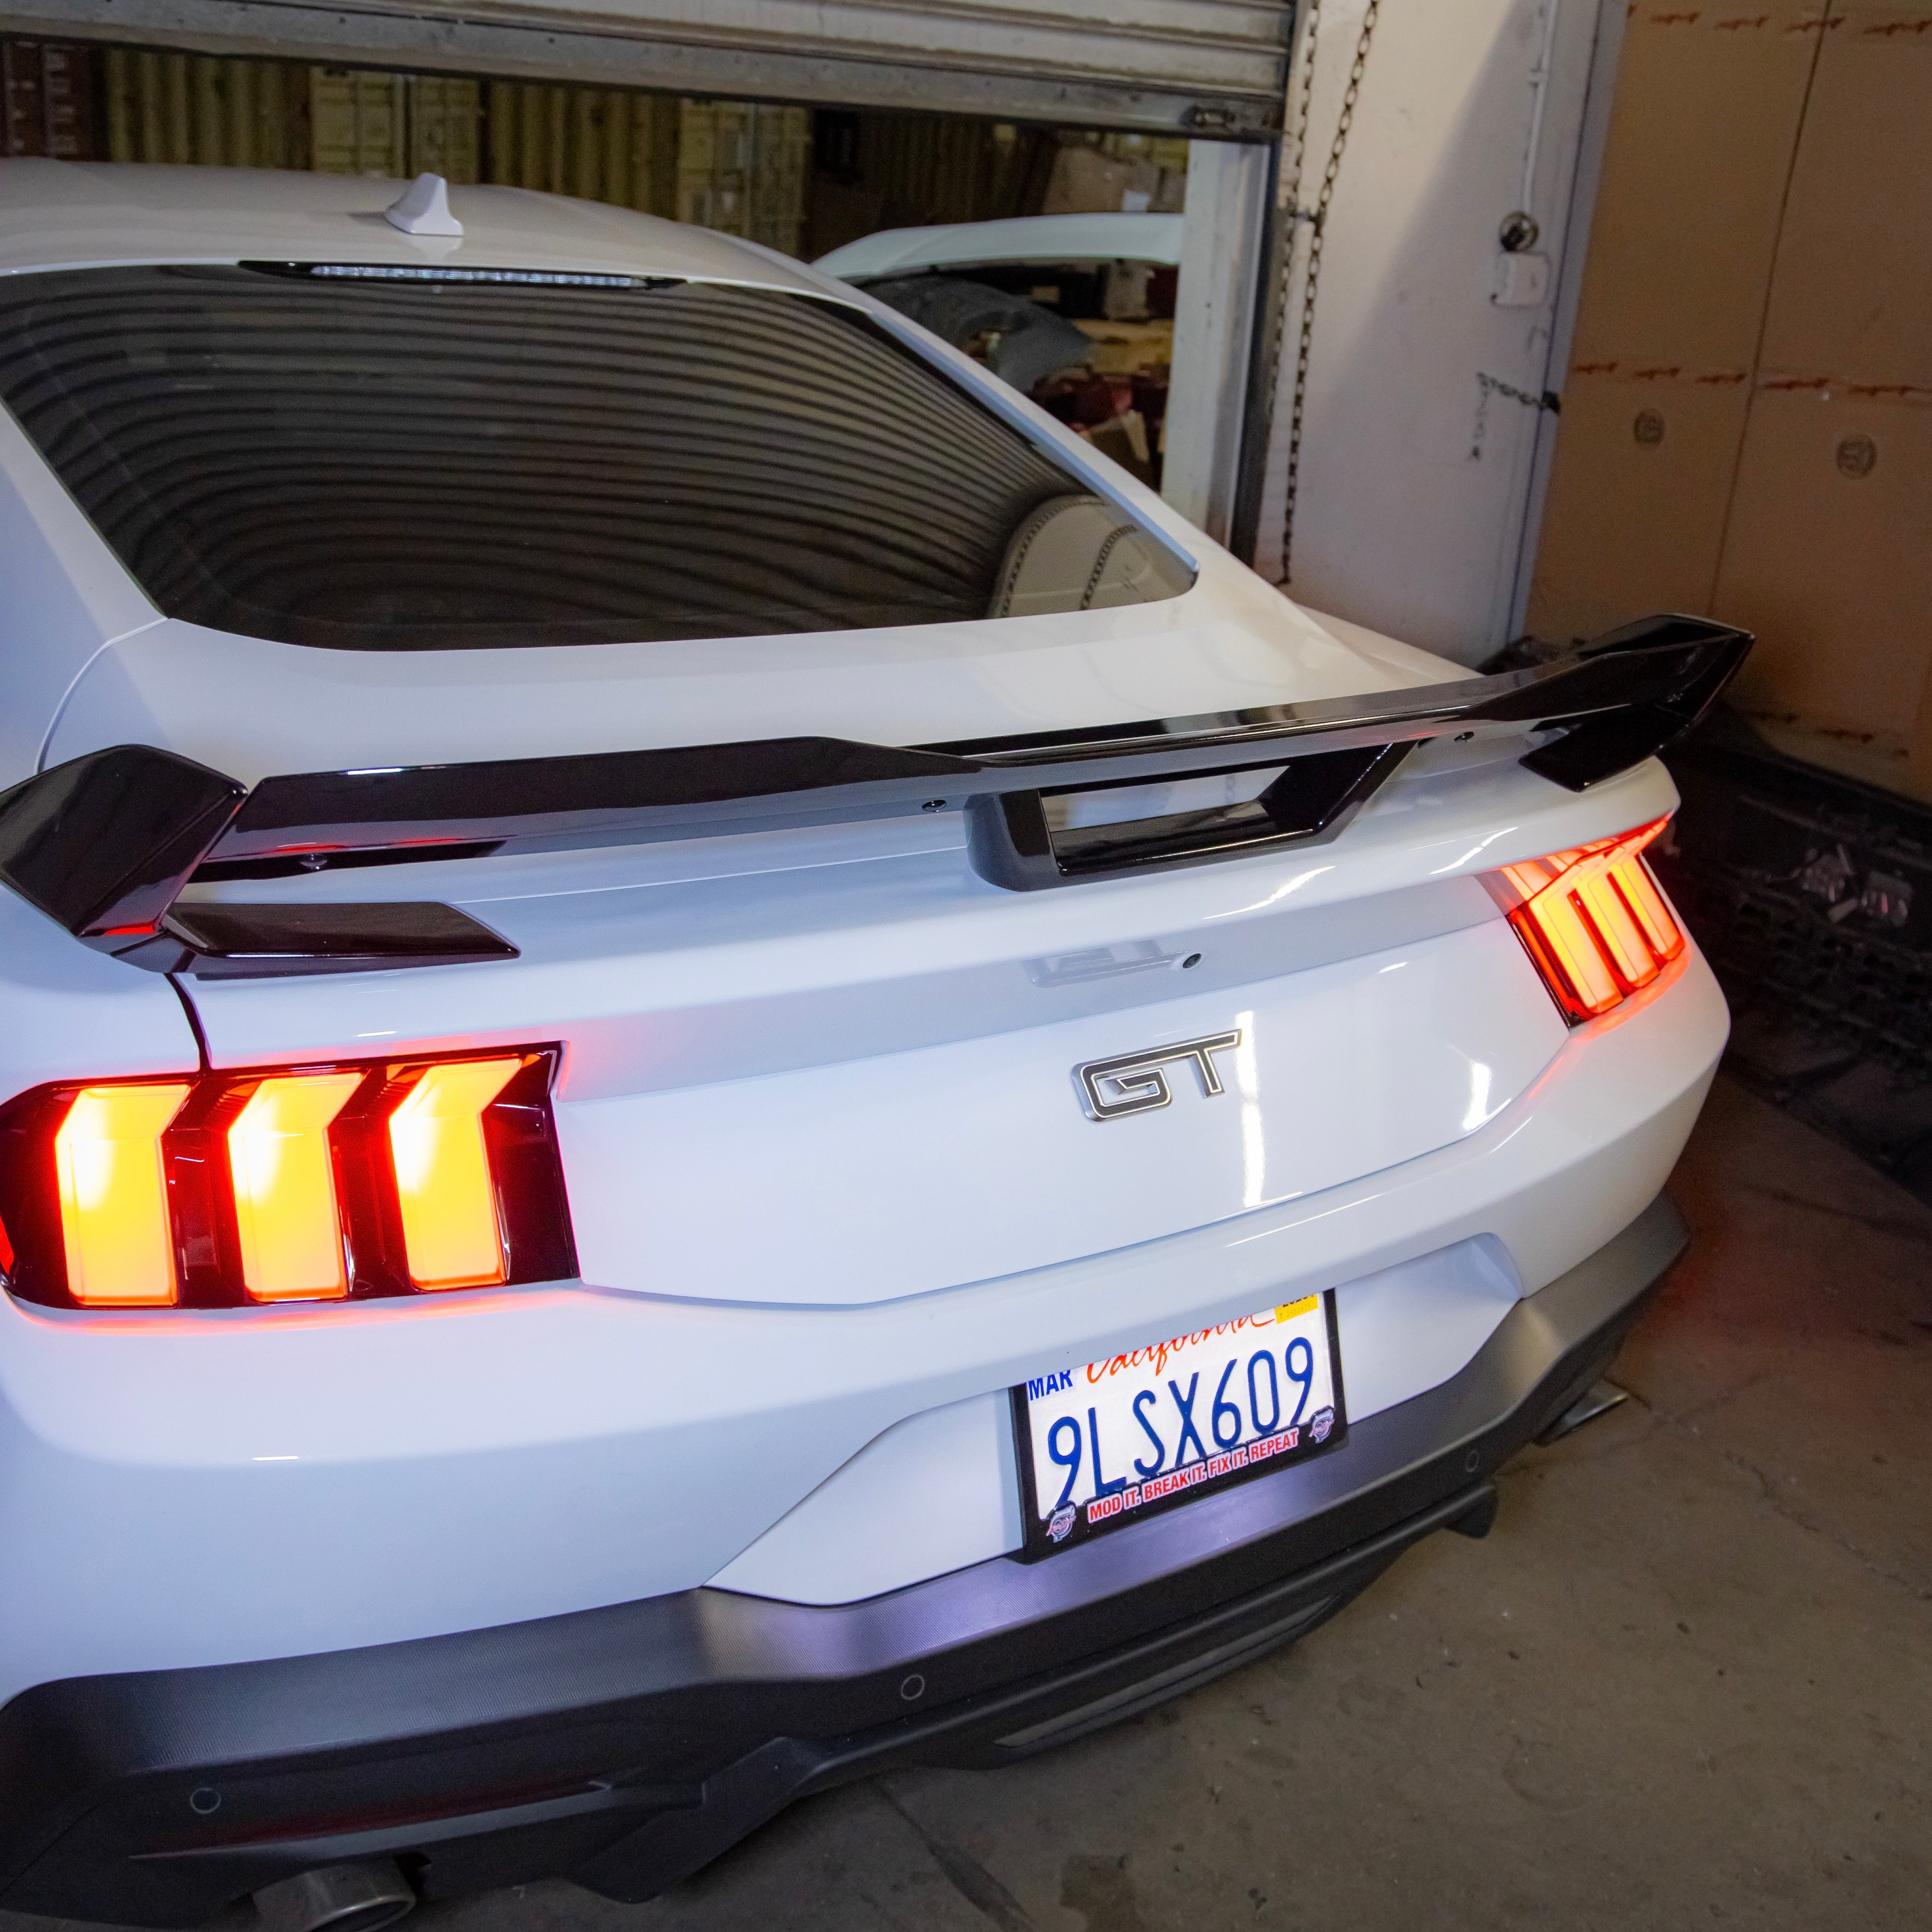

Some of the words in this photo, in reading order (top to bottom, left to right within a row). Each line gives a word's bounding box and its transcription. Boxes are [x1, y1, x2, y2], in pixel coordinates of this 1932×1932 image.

[1071, 1028, 1243, 1124] GT
[1029, 1370, 1073, 1401] MAR
[1048, 1336, 1313, 1507] 9LSX609
[1089, 1497, 1121, 1521] MOD
[1125, 1489, 1140, 1508] IT.
[1144, 1471, 1189, 1500] BREAK
[1192, 1465, 1206, 1483] IT.
[1210, 1456, 1230, 1476] FIX
[1233, 1450, 1247, 1468] IT.
[1251, 1430, 1297, 1460] REPEAT
